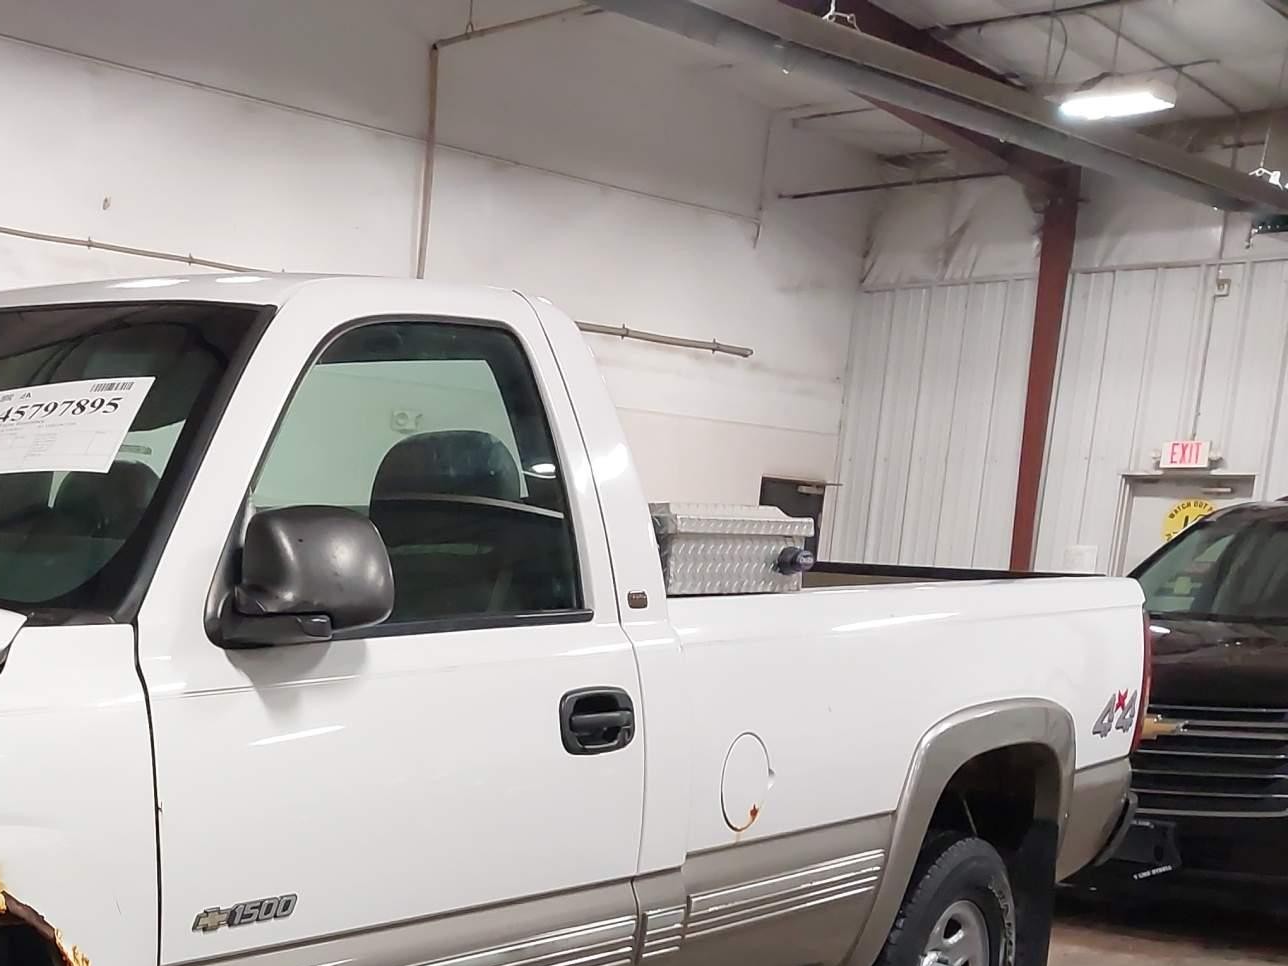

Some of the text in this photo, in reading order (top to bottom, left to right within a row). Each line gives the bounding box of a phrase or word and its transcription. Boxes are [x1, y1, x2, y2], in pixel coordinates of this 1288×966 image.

[1169, 442, 1203, 465] EXIT
[1168, 500, 1209, 520] WATCH OUT
[232, 893, 298, 926] 1500
